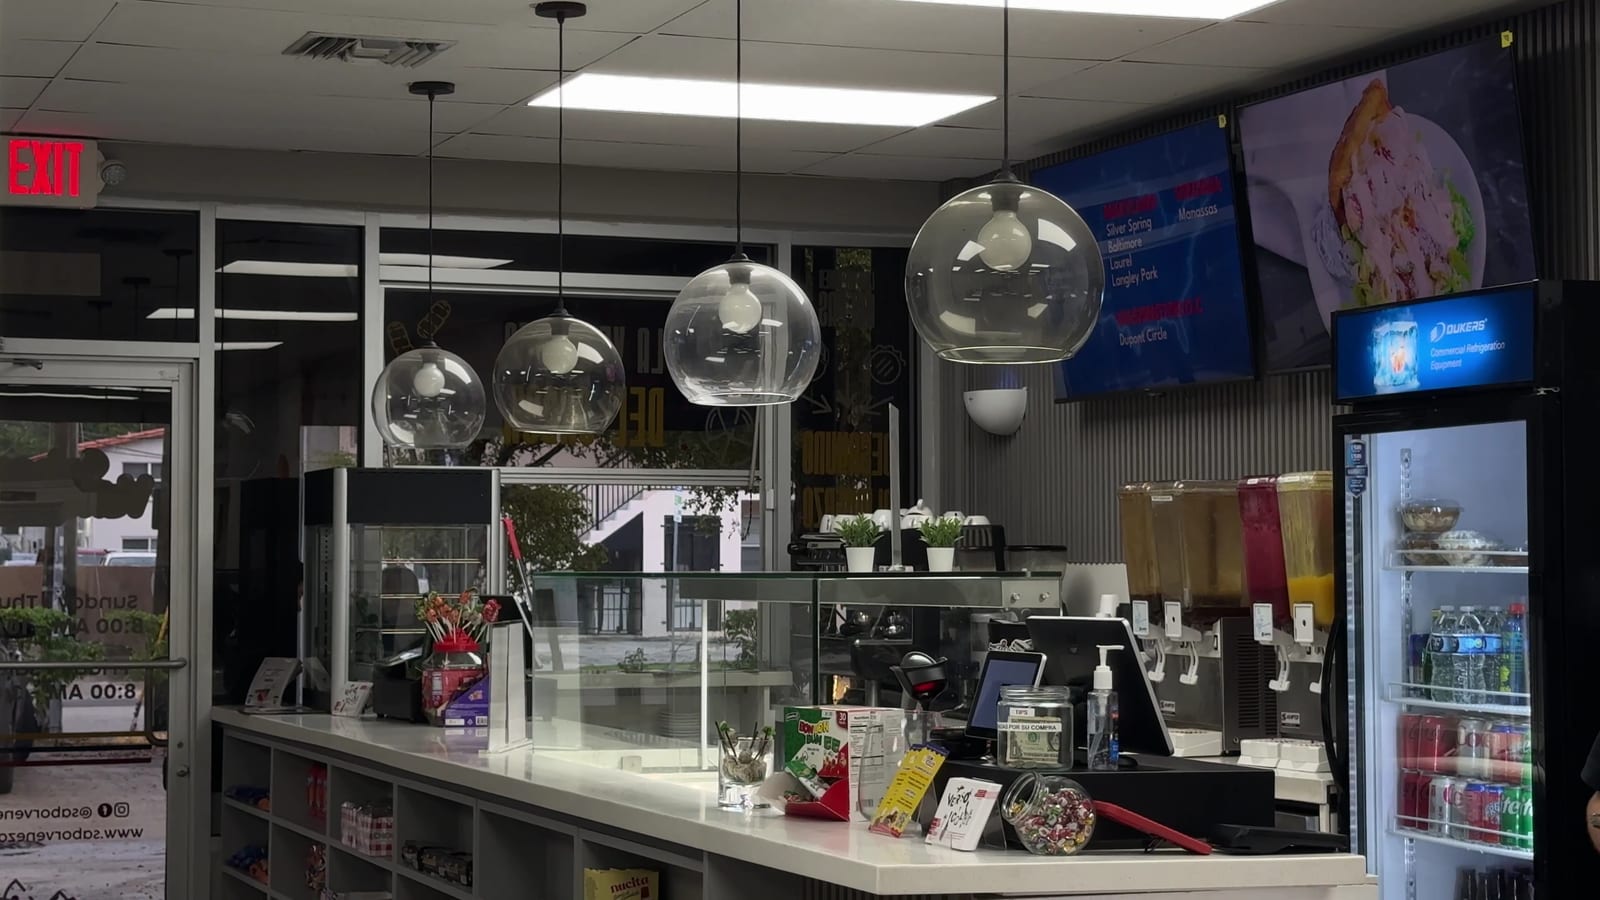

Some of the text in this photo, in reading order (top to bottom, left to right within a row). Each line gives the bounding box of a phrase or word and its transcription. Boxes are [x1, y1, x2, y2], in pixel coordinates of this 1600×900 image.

[8, 139, 84, 197] EXIT
[1178, 203, 1218, 221] Manassas
[1106, 217, 1152, 237] Silver Spring
[1107, 237, 1143, 253] Baltimore
[1109, 254, 1133, 271] Laurel
[1112, 266, 1159, 288] Langley Park
[1446, 320, 1485, 335] DUKERS
[1119, 326, 1168, 348] Dupont Circle
[1431, 340, 1505, 357] Commercial Refrigeration
[610, 876, 648, 893] nucita
